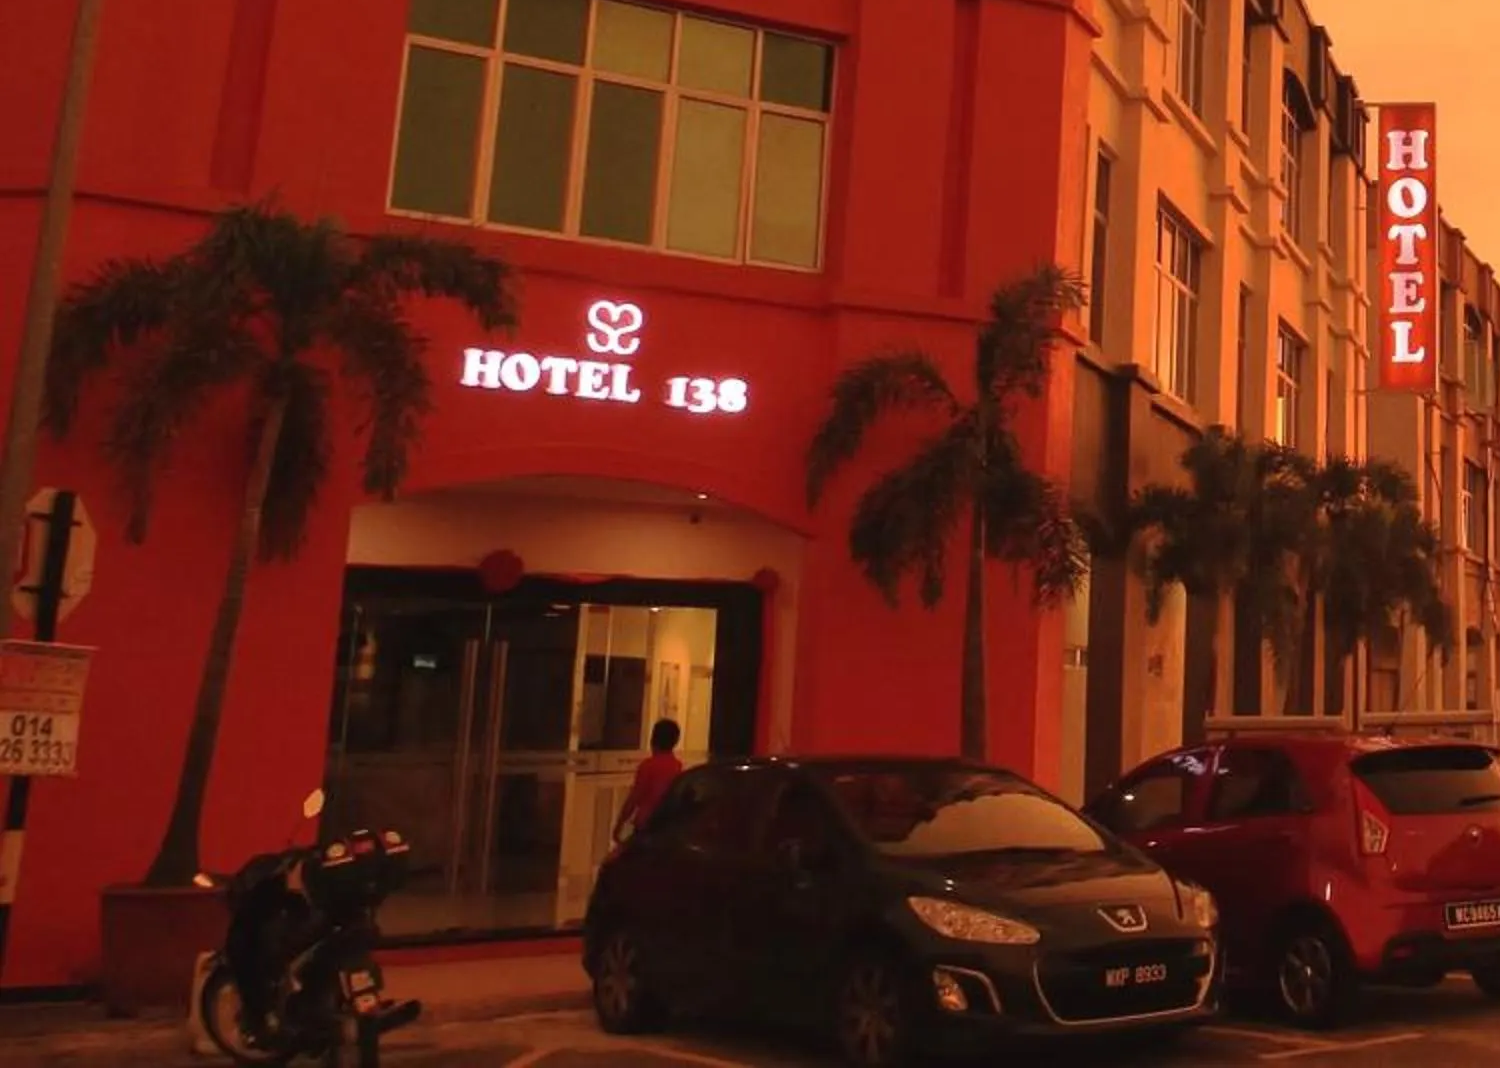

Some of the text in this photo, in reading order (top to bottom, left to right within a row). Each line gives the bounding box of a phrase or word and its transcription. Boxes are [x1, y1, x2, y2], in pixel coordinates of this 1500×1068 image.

[1386, 129, 1429, 363] HOTEL
[460, 347, 748, 414] HOTEL 138
[11, 714, 53, 738] 014
